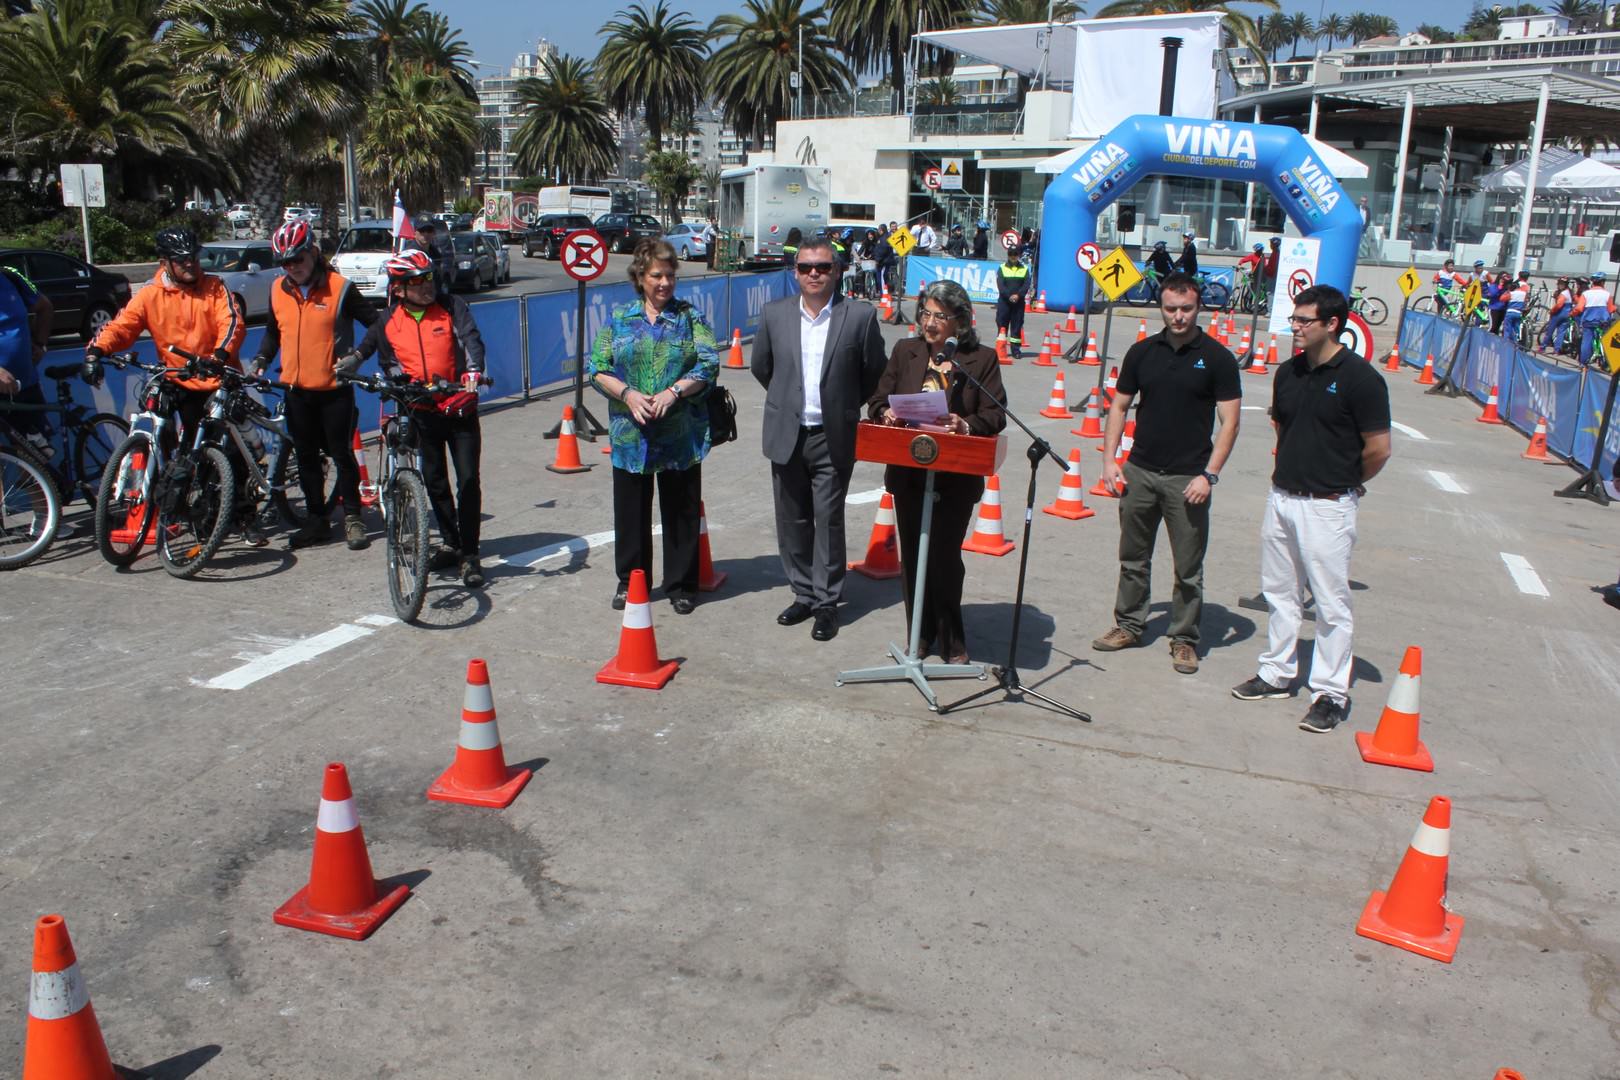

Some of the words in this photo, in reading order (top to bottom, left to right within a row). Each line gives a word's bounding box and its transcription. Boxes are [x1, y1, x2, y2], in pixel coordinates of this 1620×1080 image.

[1162, 153, 1257, 169] CIUDADDELDEPORTE.COM
[1164, 122, 1257, 160] VIÑA
[1071, 142, 1127, 186] VIÑA
[1298, 155, 1340, 211] VIÑA
